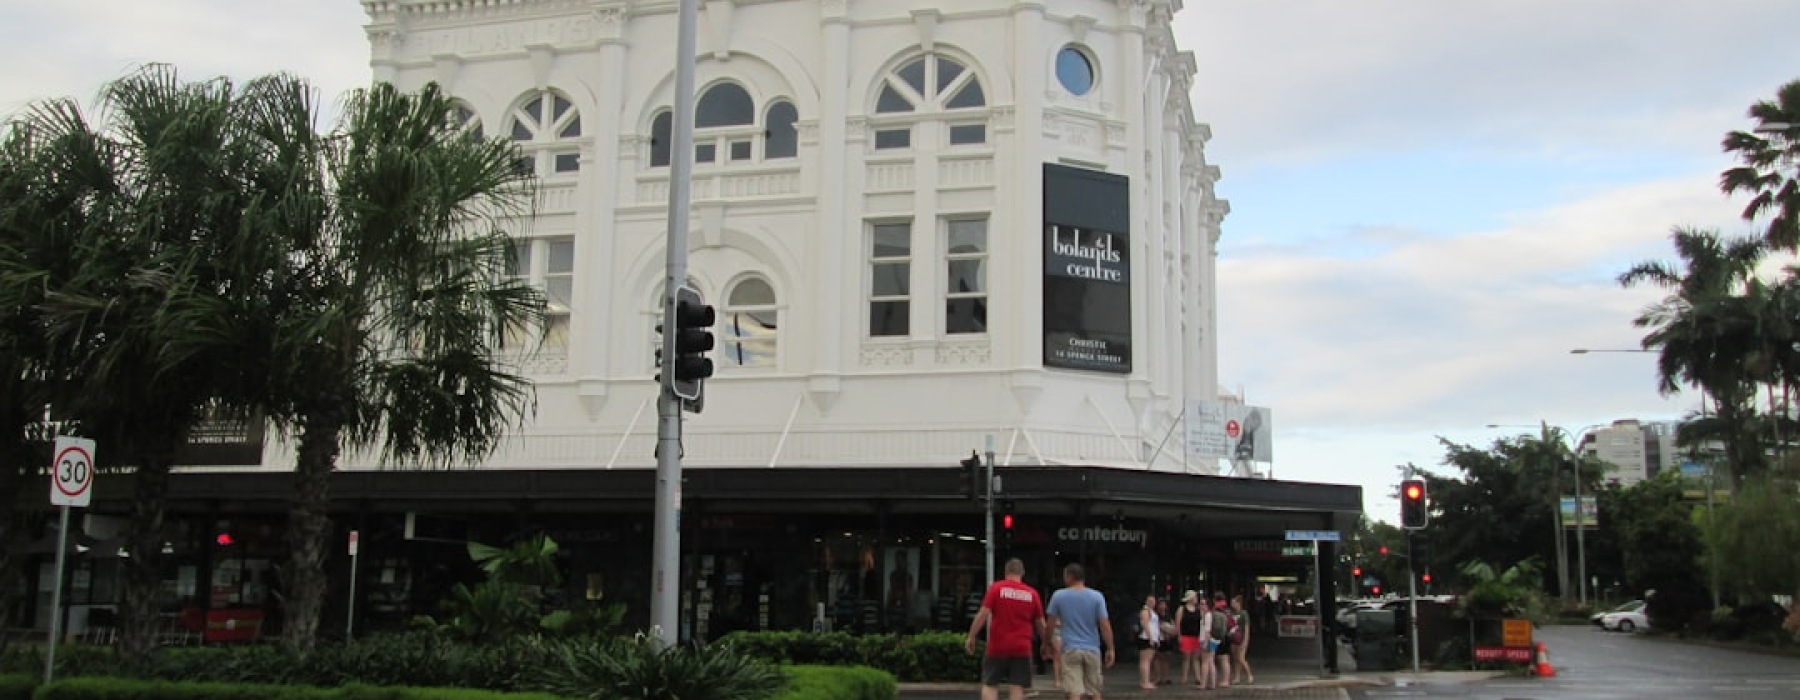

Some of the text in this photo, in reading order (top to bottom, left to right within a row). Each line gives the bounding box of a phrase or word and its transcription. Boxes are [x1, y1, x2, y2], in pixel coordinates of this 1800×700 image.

[1066, 250, 1121, 282] centre
[60, 460, 86, 484] 30
[1058, 523, 1147, 549] canterbury
